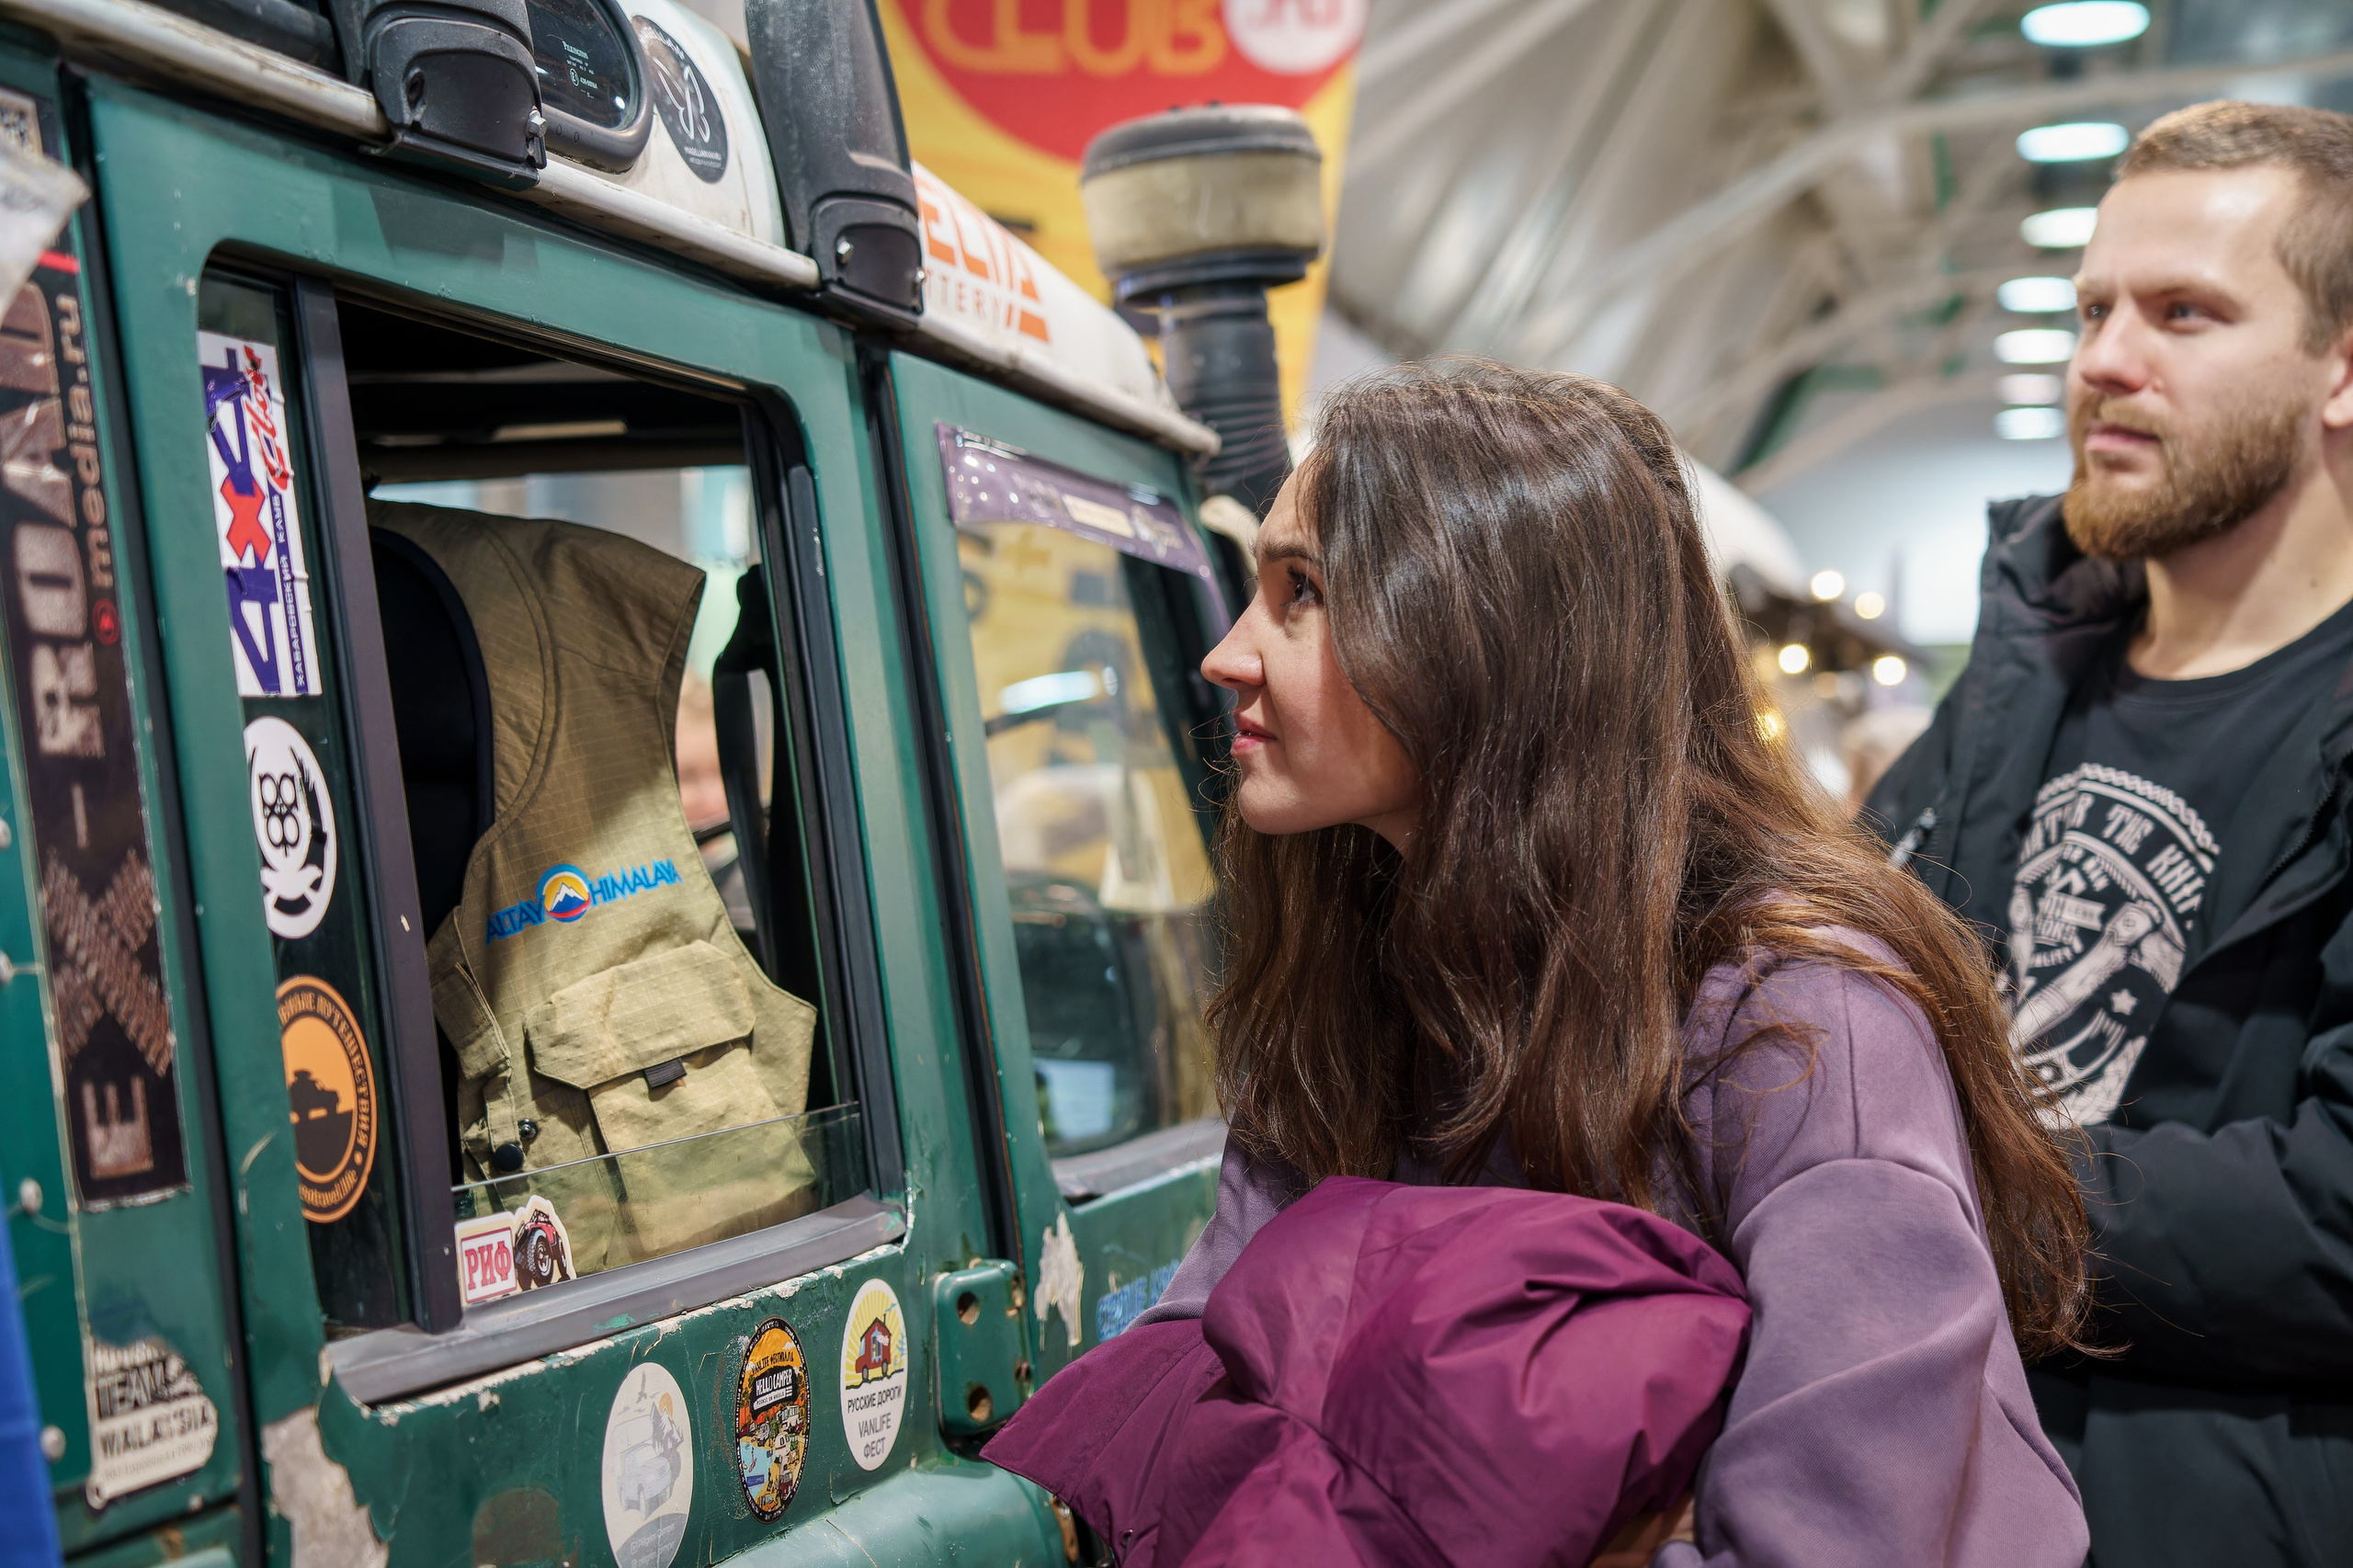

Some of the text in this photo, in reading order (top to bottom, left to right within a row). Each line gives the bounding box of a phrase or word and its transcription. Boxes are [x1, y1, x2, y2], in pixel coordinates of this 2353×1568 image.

[271, 494, 305, 687] ХАБАРОВСКИЙ КЛУБ
[2102, 803, 2154, 855] THE
[485, 898, 546, 948] ALTAY
[316, 993, 370, 1149] ПУТЕШЕСТВИЯ
[464, 1241, 512, 1291] РИФ
[756, 1369, 792, 1396] HELLO CAMPER
[847, 1384, 903, 1414] РУССКИЕ ДОРОГИ
[858, 1412, 892, 1438] VANLIFE
[863, 1437, 886, 1460] ФЕСТ
